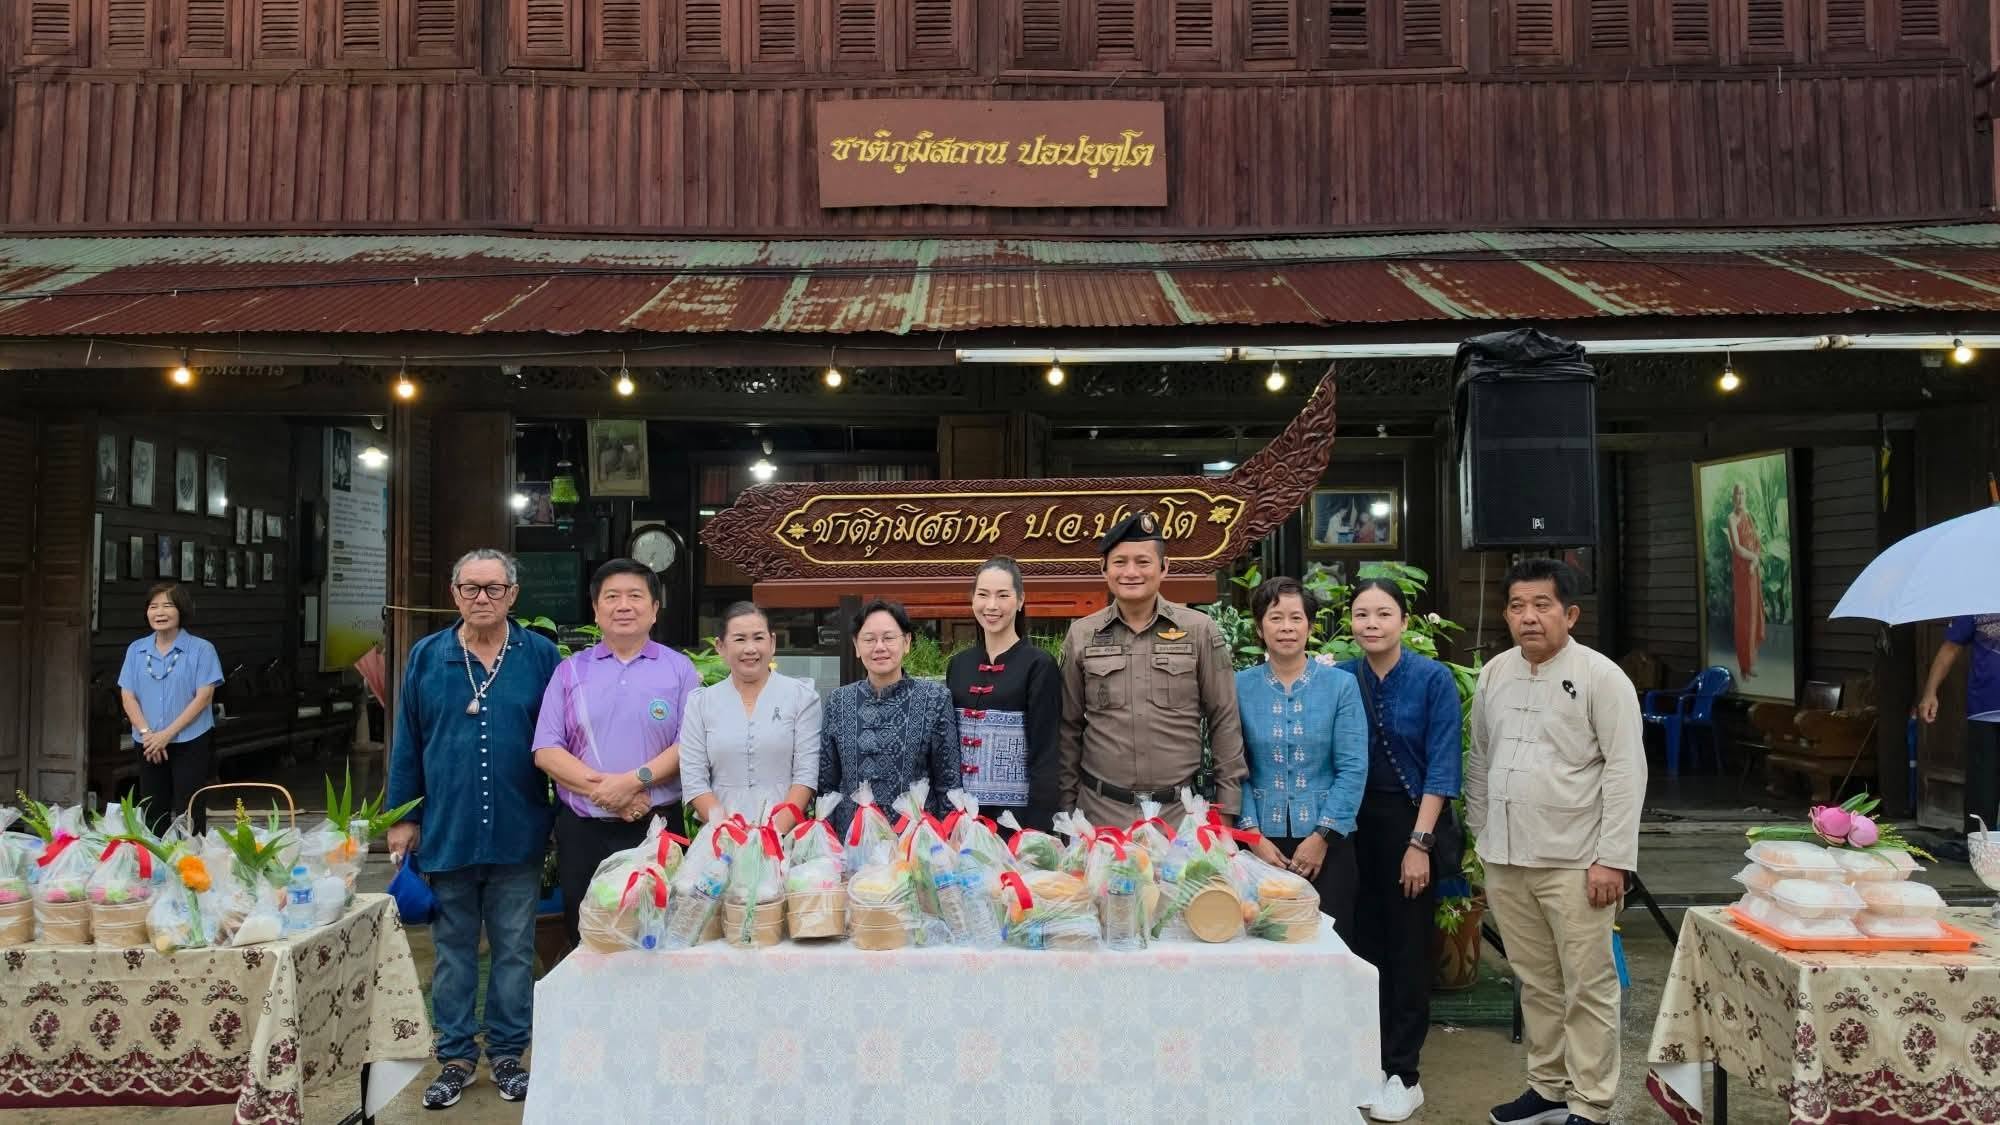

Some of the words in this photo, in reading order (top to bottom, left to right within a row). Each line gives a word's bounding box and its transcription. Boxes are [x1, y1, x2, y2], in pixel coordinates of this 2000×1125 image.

[830, 128, 1011, 174] ชาติภูมิสถาน
[811, 504, 1013, 557] ชาติภูมิสถาน
